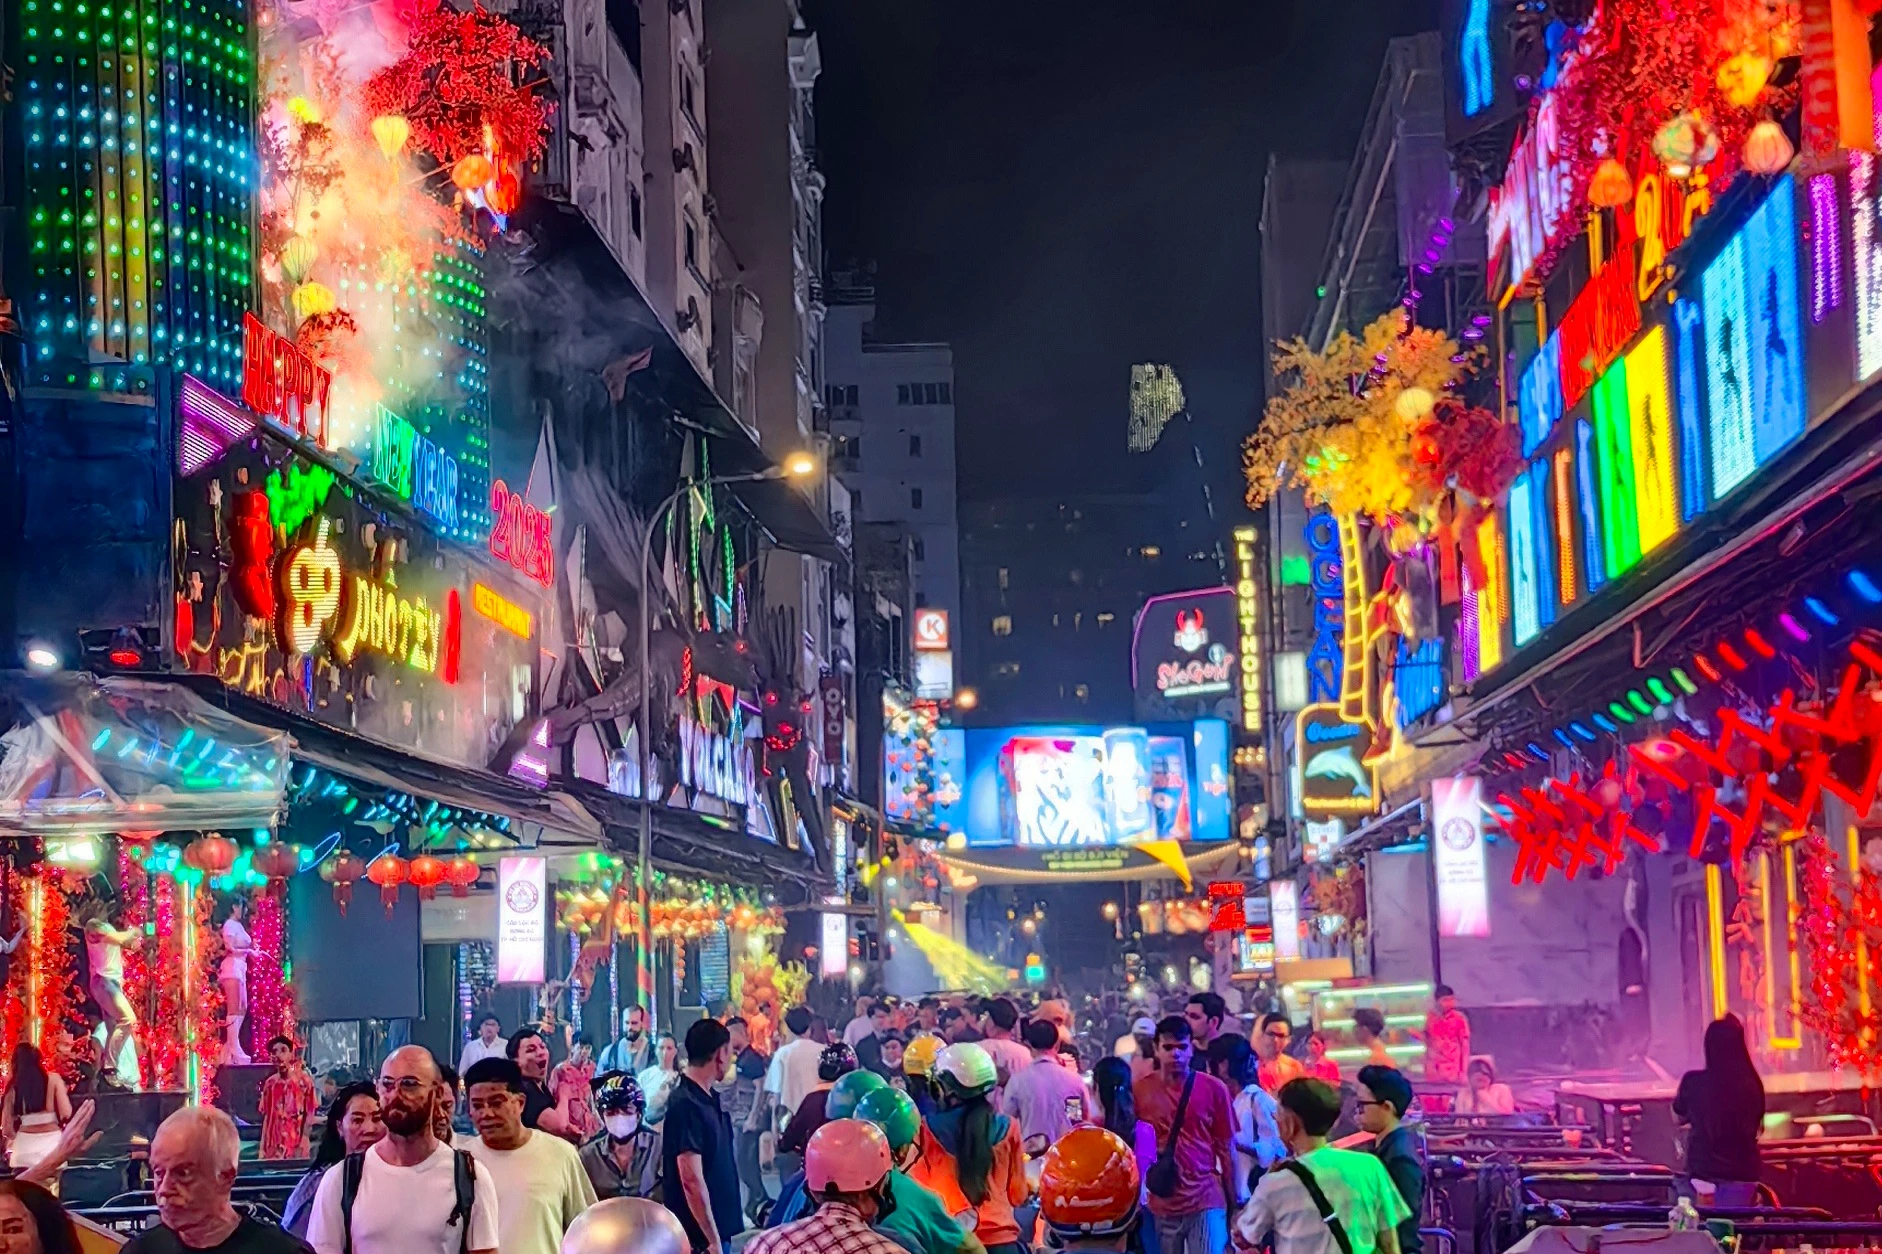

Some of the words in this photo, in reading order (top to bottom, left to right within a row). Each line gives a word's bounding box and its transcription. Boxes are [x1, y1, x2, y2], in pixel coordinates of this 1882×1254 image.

[242, 311, 331, 450] HAPPY
[413, 431, 459, 527] YEAR
[490, 479, 554, 588] 2025
[825, 687, 842, 736] OYO
[1237, 543, 1262, 731] LIGHTHOUSE
